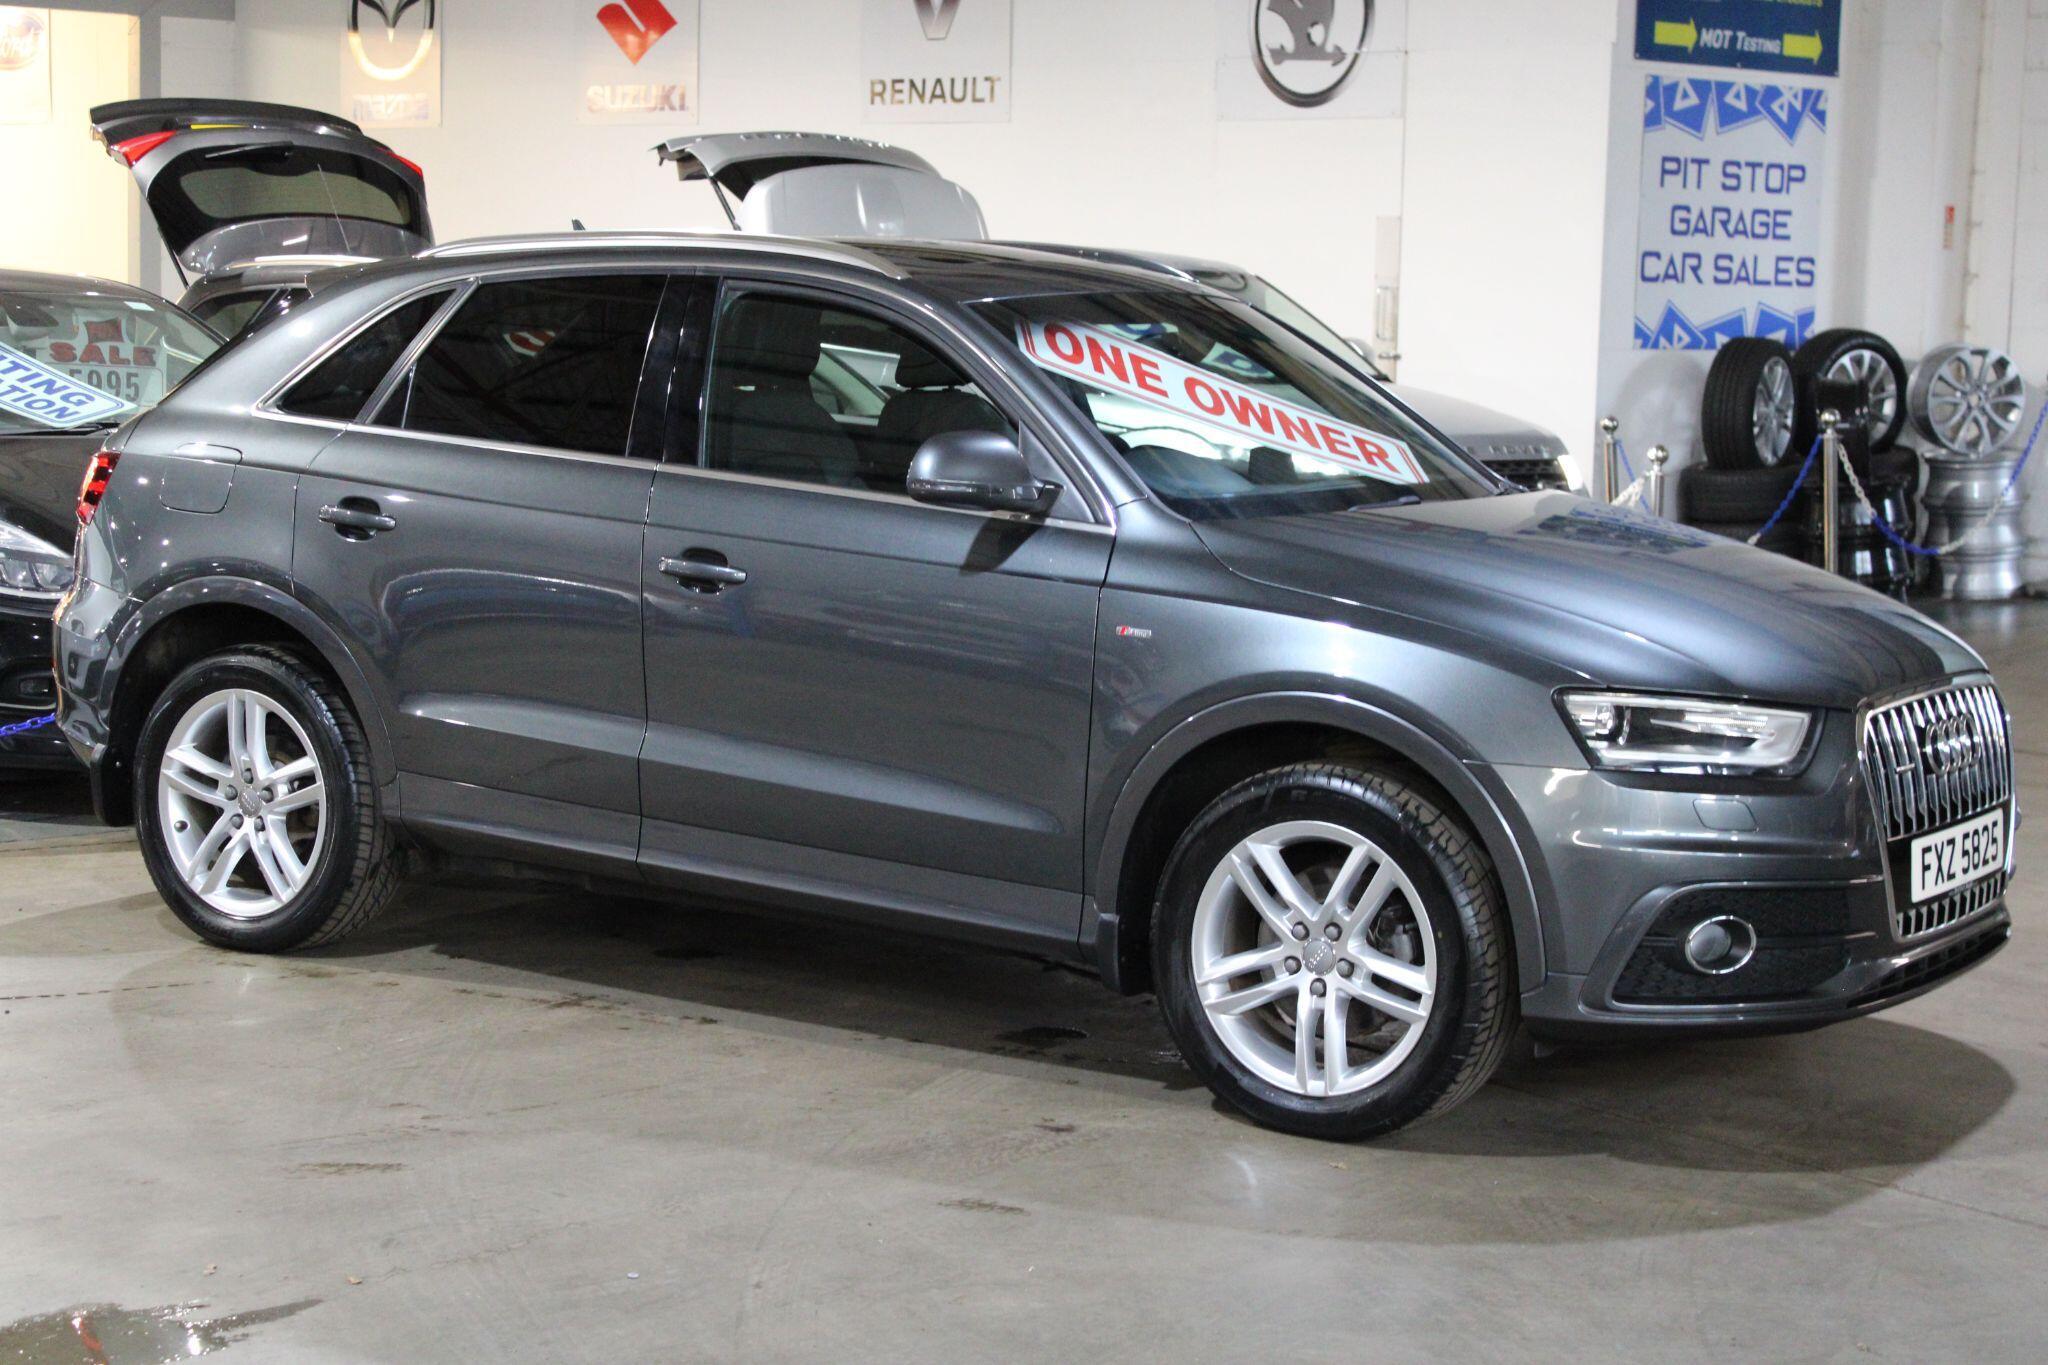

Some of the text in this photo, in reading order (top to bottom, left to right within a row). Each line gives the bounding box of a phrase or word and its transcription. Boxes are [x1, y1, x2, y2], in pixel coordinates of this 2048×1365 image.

[1699, 27, 1734, 49] MOT
[586, 83, 687, 113] SUZUKI
[868, 76, 1002, 106] RENAULT
[1659, 155, 1807, 195] PIT STOP
[1669, 204, 1793, 241] GARAGE
[1639, 250, 1817, 288] CAR SALES
[50, 341, 158, 367] SALE
[0, 355, 96, 407] TING
[0, 379, 81, 419] TION
[1043, 324, 1170, 400] ONE
[1183, 376, 1402, 476] OWNER
[1921, 819, 1999, 891] FXZ 5825
